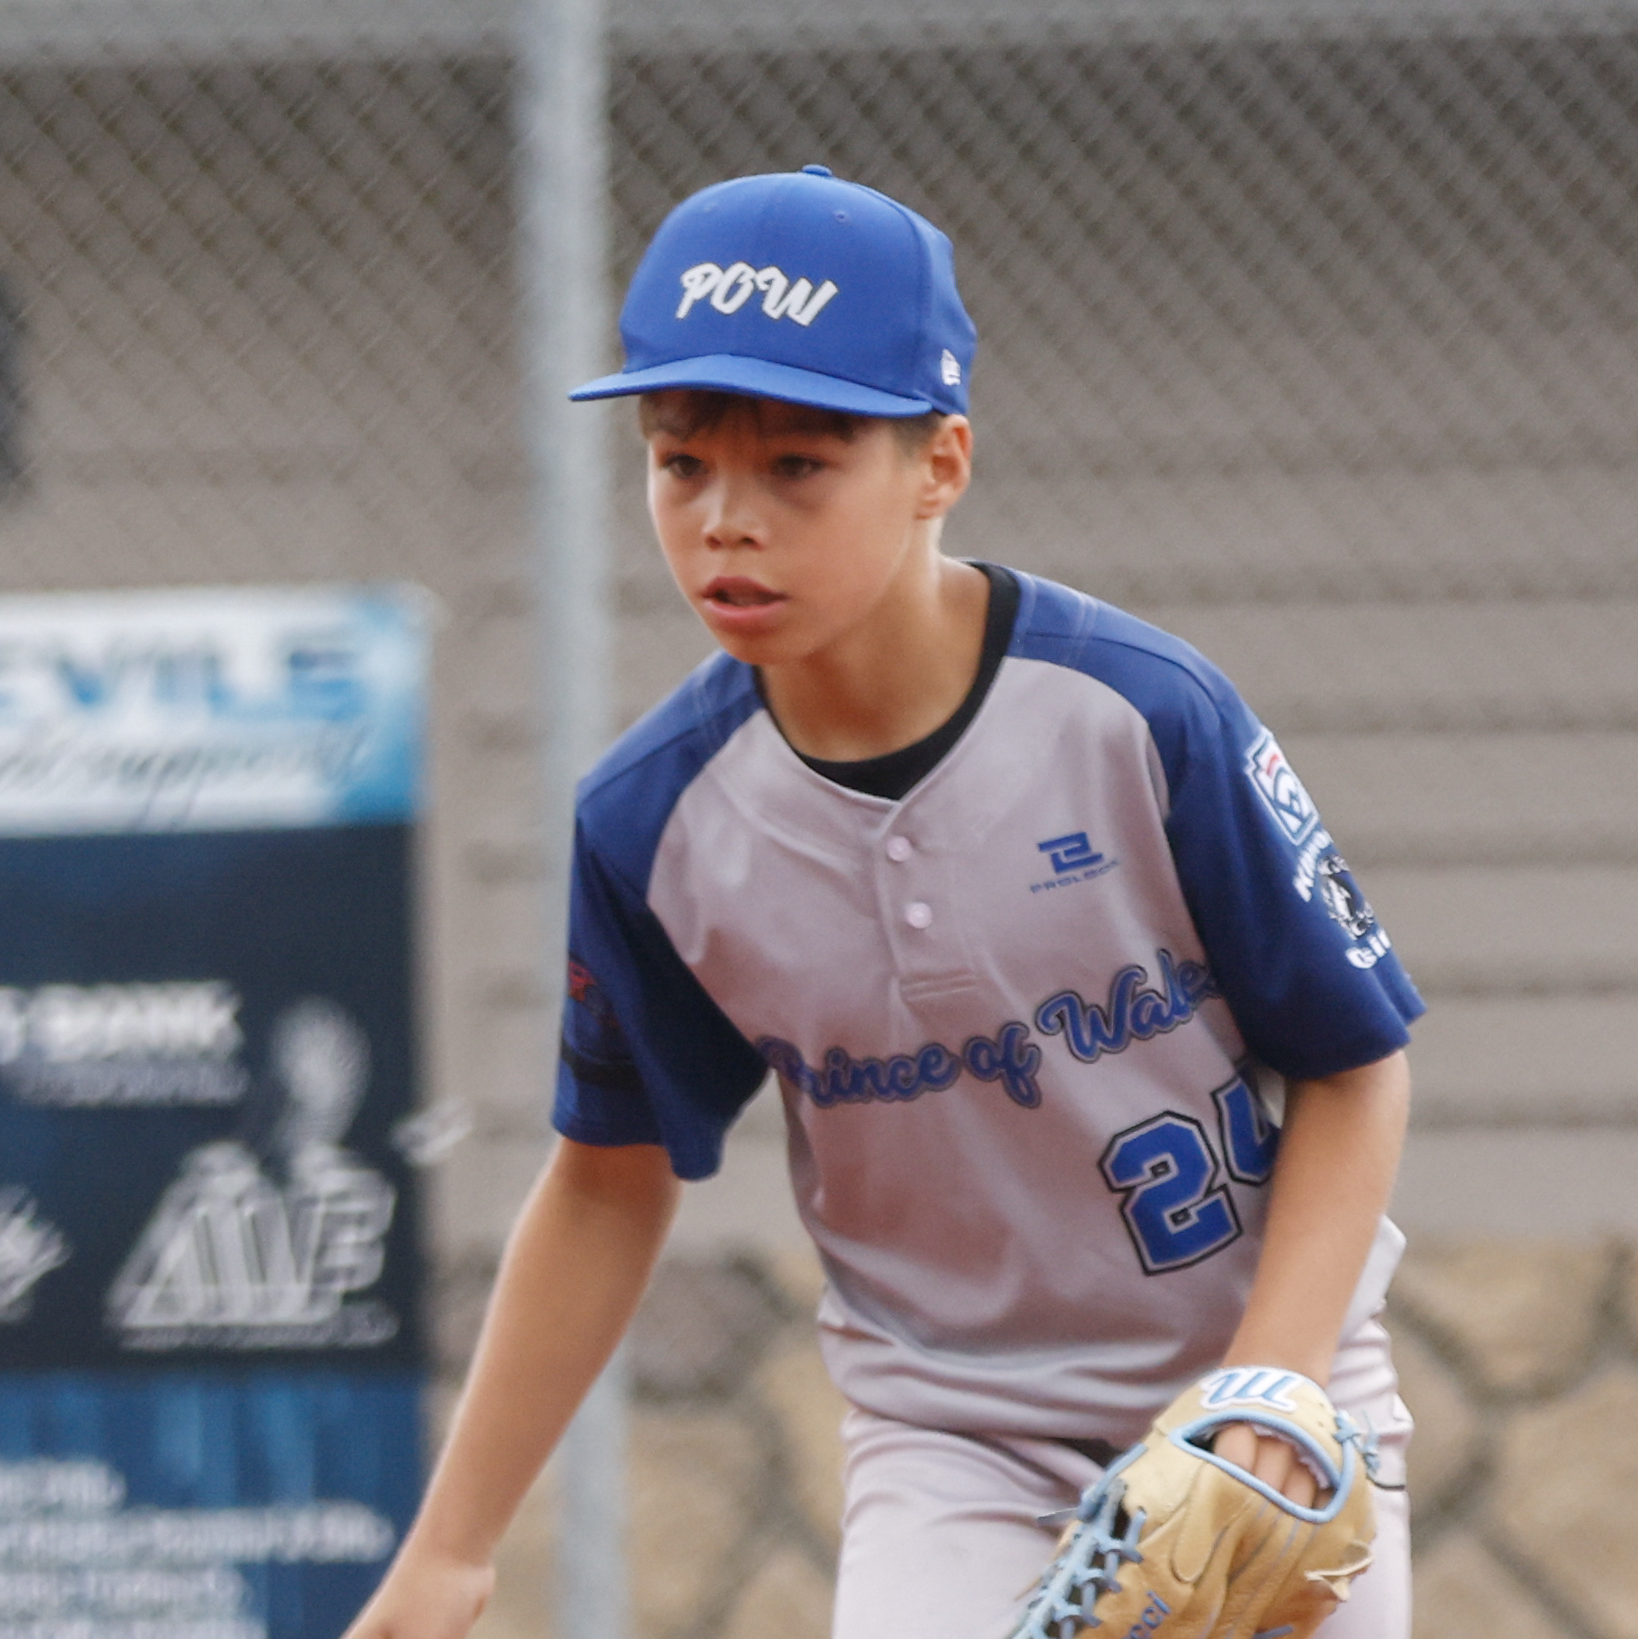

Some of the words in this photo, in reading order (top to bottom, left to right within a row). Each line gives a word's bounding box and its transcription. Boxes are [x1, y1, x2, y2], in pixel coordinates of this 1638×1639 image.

[676, 261, 839, 327] POW
[961, 1020, 1042, 1109] of
[1034, 948, 1219, 1065] Wale
